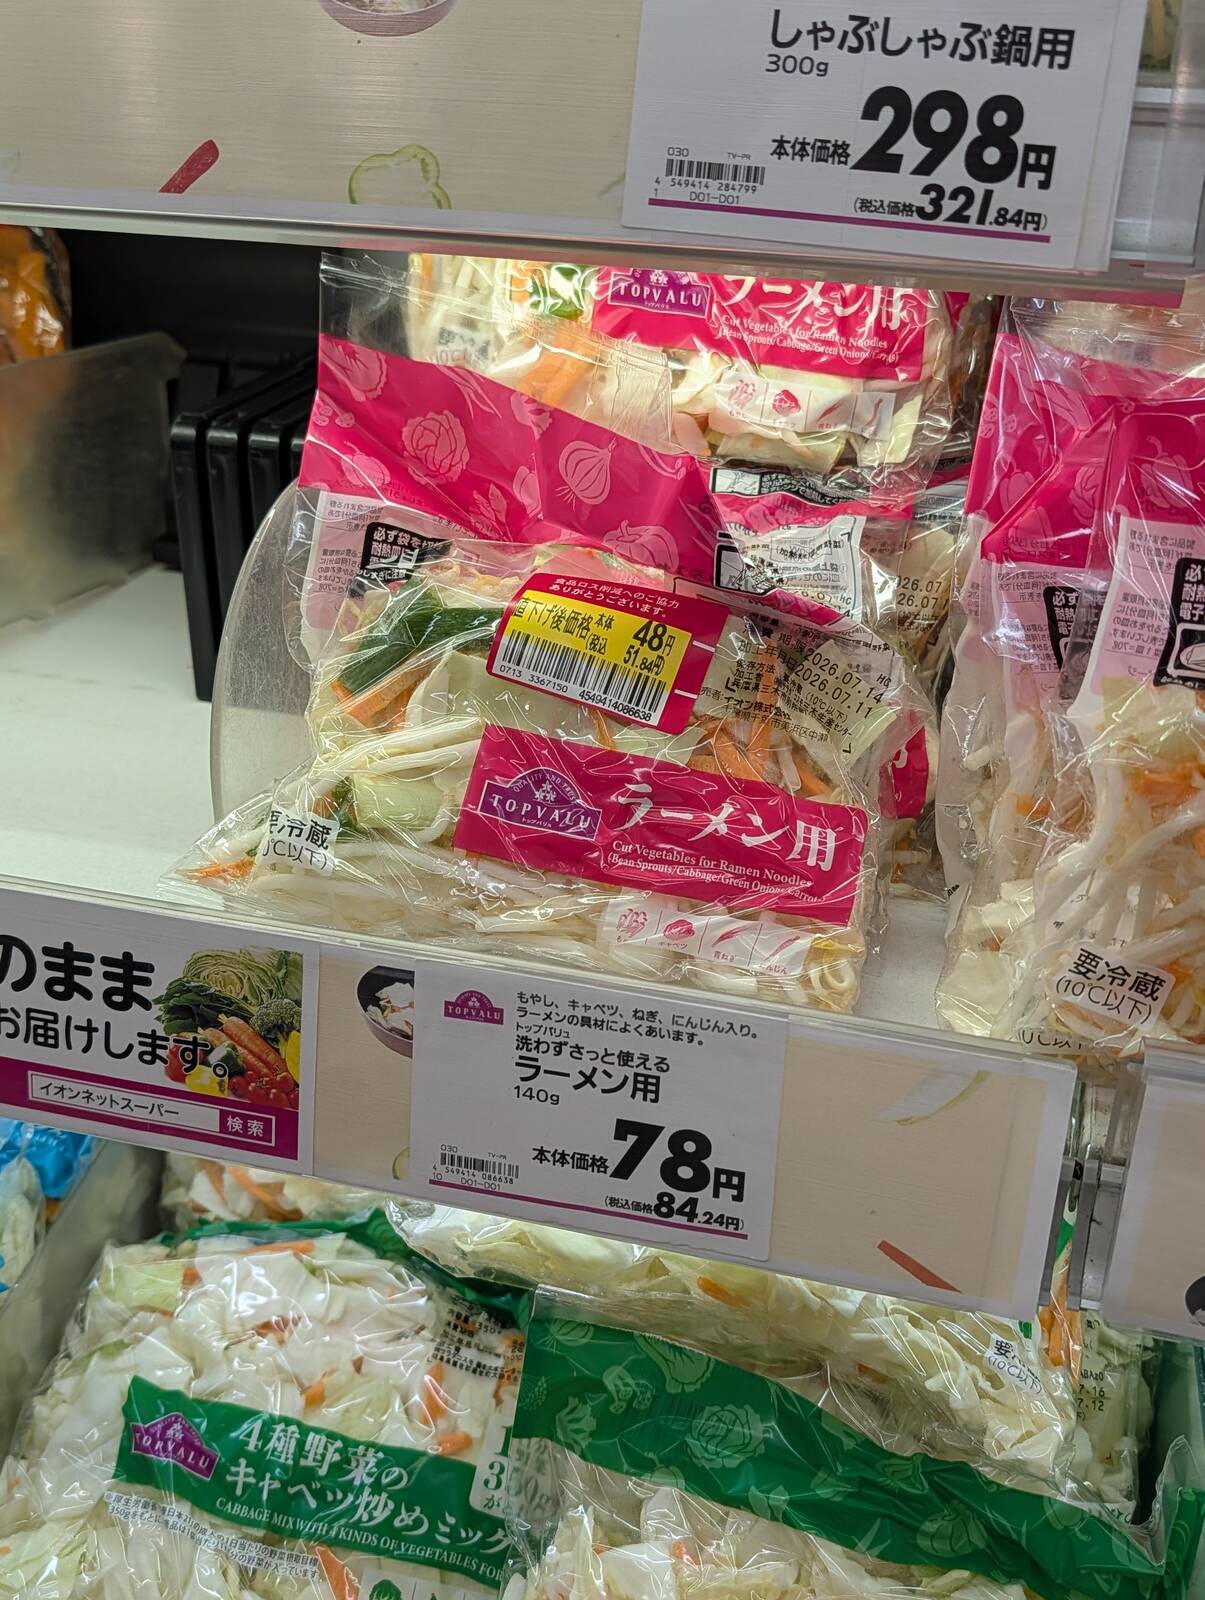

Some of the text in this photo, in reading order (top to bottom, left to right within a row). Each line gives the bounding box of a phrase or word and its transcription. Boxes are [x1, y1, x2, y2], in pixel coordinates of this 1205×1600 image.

[771, 8, 1075, 71] しゃぶしゃぶ鍋用
[764, 53, 829, 77] 300g
[667, 146, 690, 158] 030
[670, 178, 710, 189] 549414
[717, 182, 757, 194] 284799
[619, 282, 702, 307] TOPVALU
[848, 335, 888, 350] Noodles
[549, 584, 668, 618] ありがとうございます。
[554, 578, 680, 610] 食品ロス削減へのご協力
[585, 633, 608, 655] (税込
[594, 613, 616, 631] 本体
[632, 620, 676, 657] 48円
[499, 664, 653, 722] 0713 3367150 4549414086638
[491, 793, 592, 829] TOPVALU
[613, 783, 838, 872] ラーメン用
[607, 851, 635, 866] (Bean
[612, 840, 813, 888] Cut Vegetables for Ramen Noodles
[1068, 947, 1167, 1002] 要冷蔵
[447, 1005, 501, 1020] TOPVALU
[1055, 975, 1153, 1025] (10℃以下)
[0, 1006, 230, 1080] お届けします。
[515, 1006, 705, 1047] ラーメンの具材によくあいます。
[515, 1022, 572, 1039] トップバリュ
[515, 1034, 671, 1074] 洗わずさっと使える
[513, 1085, 561, 1106] 140g
[514, 1056, 661, 1104] ラーメン用
[39, 1081, 180, 1119] イオンネットスーパー
[445, 1167, 477, 1179] 549414
[237, 1420, 408, 1491] 4種野菜の
[216, 1496, 271, 1521] CABBAGE
[271, 1513, 295, 1530] MIX
[295, 1519, 328, 1537] WITH
[337, 1526, 379, 1546] KINDS
[380, 1535, 399, 1550] OF
[400, 1541, 479, 1570] VEGETABLES
